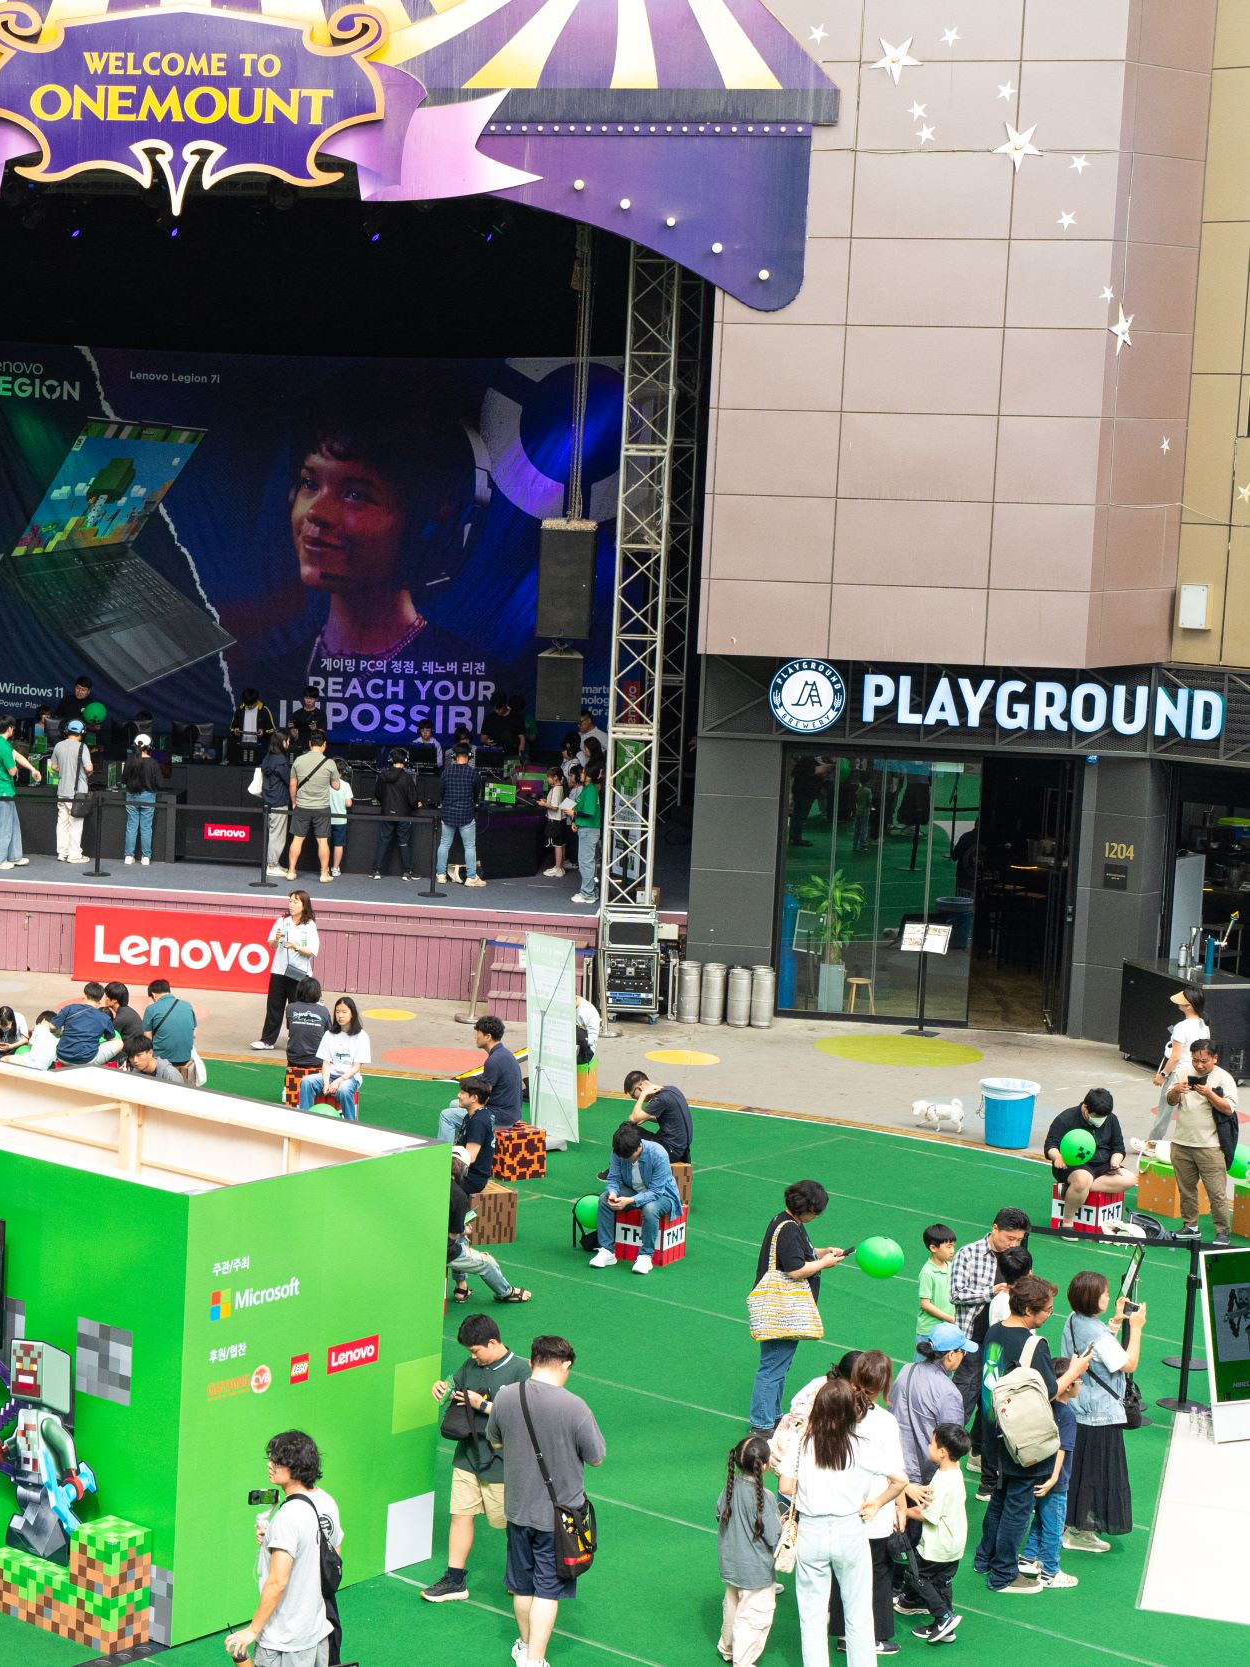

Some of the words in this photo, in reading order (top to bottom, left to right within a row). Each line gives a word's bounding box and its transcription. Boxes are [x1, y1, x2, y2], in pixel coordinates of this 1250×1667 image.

[83, 52, 227, 77] WELCOME
[239, 53, 281, 78] TO
[30, 84, 333, 125] ONEMOUNT
[130, 370, 169, 382] Lenovo
[171, 372, 208, 384] Legion
[210, 374, 220, 384] 7i
[320, 658, 356, 672] 게이밍
[359, 659, 387, 673] PC의
[390, 661, 419, 675] 정점,
[421, 661, 458, 675] 레노버
[461, 662, 486, 675] 리전
[775, 661, 842, 690] PLAYGROUND
[0, 682, 53, 698] Windows
[54, 686, 64, 699] 11
[308, 676, 405, 700] REACH
[414, 680, 496, 702] YOUR
[862, 673, 1227, 740] PLAYGROUND
[781, 713, 830, 729] BREWERY
[207, 826, 246, 839] Lenovo
[1104, 842, 1135, 860] 1204
[93, 924, 270, 974] Lenovo
[1101, 1204, 1122, 1222] TNT
[666, 1224, 685, 1246] TNT
[211, 1255, 250, 1277] 주관/주최
[234, 1276, 300, 1311] Microsoft
[208, 1342, 247, 1364] 후원/협찬
[330, 1344, 375, 1367] Lenovo
